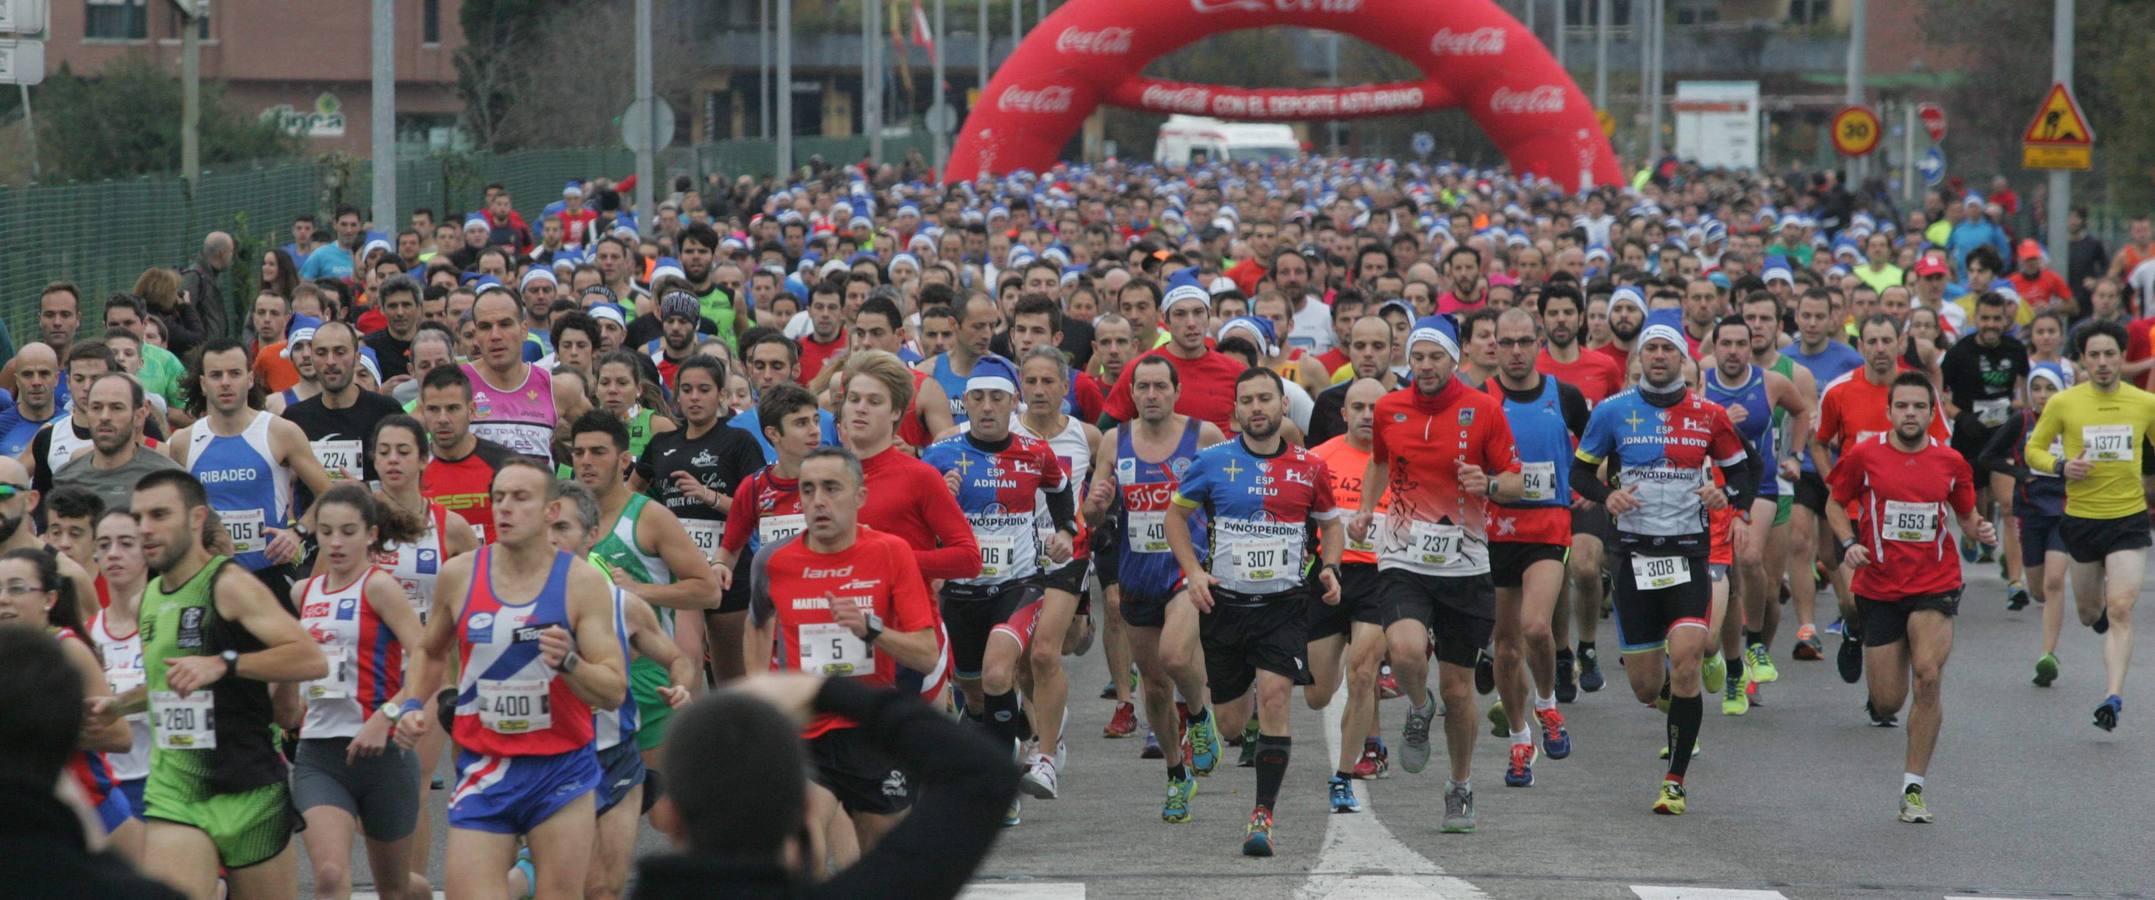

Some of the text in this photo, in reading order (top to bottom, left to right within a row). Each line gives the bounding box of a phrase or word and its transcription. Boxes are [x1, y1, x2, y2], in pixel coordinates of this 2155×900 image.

[1056, 26, 1134, 54] Coca-Cola
[1431, 27, 1505, 55] Coca-Cola
[998, 84, 1074, 112] Coca-Cola
[1490, 85, 1565, 113] Coca-Cola
[1845, 124, 1869, 140] 30
[1656, 426, 1674, 434] ESP
[1622, 436, 1708, 448] JONATHAN BOTO
[2095, 435, 2121, 450] 1377
[323, 452, 347, 468] 224
[200, 468, 257, 483] RIBADEO
[987, 468, 1006, 476] ESP
[1255, 476, 1275, 485] ESP
[1248, 486, 1278, 496] PELU
[1898, 513, 1925, 529] 653
[1422, 535, 1449, 553] 237
[1247, 550, 1275, 568] 307
[1647, 559, 1675, 577] 308
[832, 638, 843, 660] 5
[494, 696, 530, 716] 400
[164, 708, 195, 730] 260
